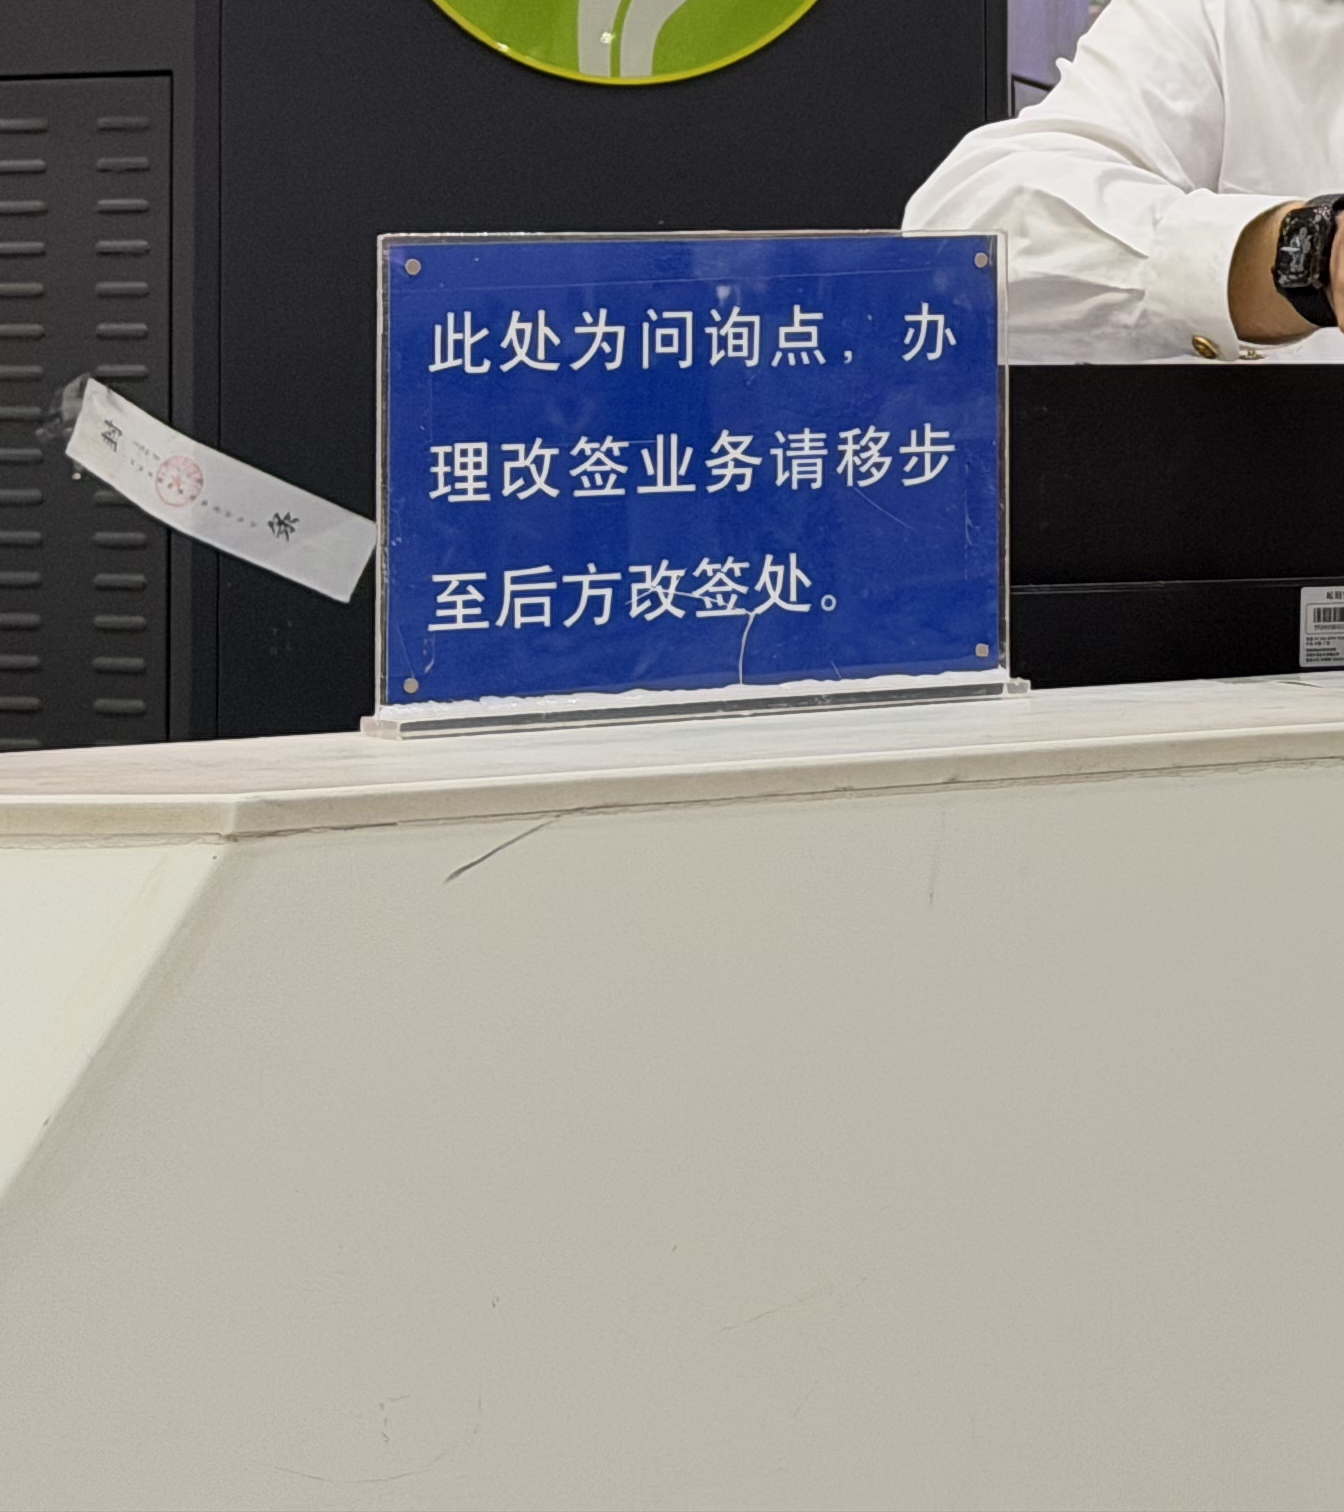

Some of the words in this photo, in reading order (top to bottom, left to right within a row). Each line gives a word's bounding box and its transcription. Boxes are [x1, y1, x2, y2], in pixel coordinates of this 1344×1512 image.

[428, 301, 957, 373] 此处为问询点，办
[428, 423, 956, 503] 理改签业务请移步
[427, 554, 838, 632] 至后方改签处。
